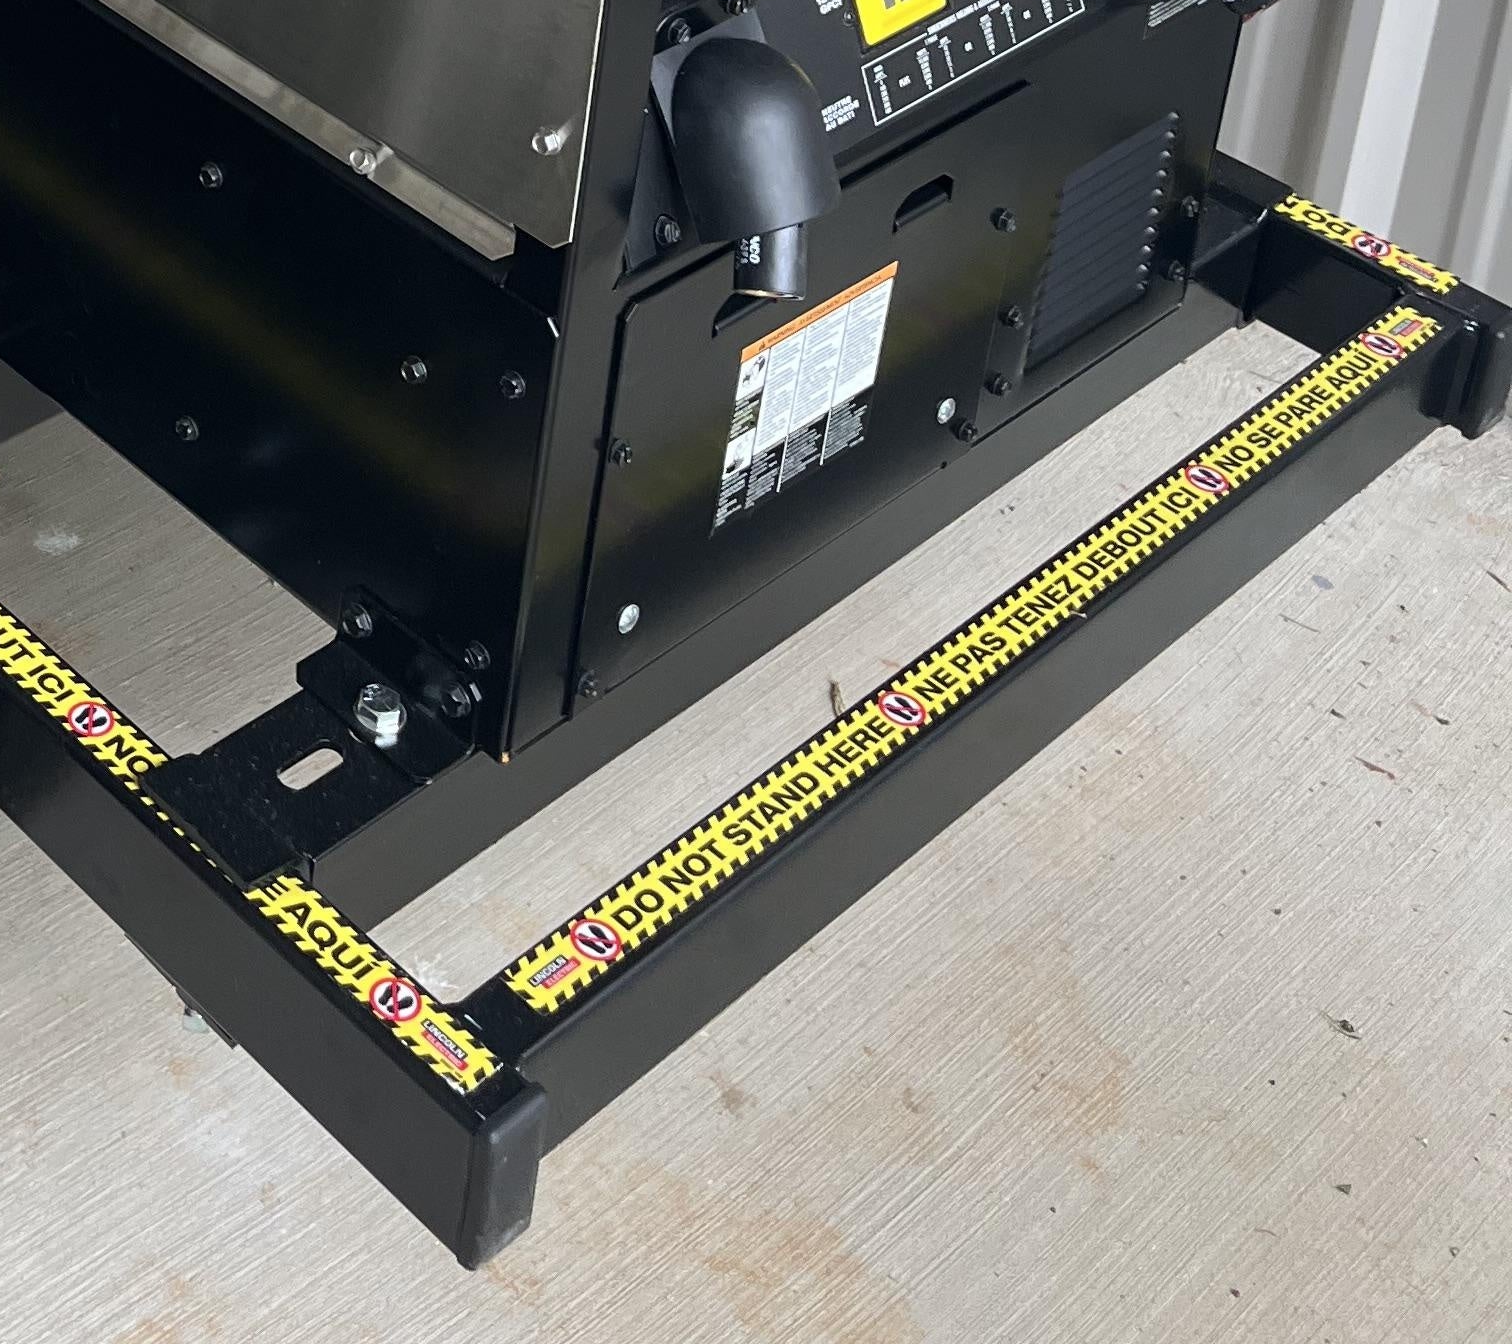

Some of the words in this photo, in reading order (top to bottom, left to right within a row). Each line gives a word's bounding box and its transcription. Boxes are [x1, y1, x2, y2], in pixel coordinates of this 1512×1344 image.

[1304, 210, 1351, 236] DO
[1216, 444, 1255, 474] NO
[1245, 419, 1284, 450] SE
[1274, 380, 1331, 430] PARE
[914, 664, 956, 702] NE
[949, 634, 1007, 678] PAS
[997, 576, 1079, 636] TENEZ
[1071, 511, 1167, 584] DEBOUT
[1160, 485, 1200, 516] ICI
[29, 659, 76, 703] ICI
[103, 734, 155, 777] NO
[610, 891, 665, 931] DO
[661, 839, 729, 896] NOT
[722, 772, 821, 858] STAND
[814, 714, 895, 778] HERE
[530, 956, 567, 986] LINCOLN
[423, 1020, 466, 1059] LINCOLN
